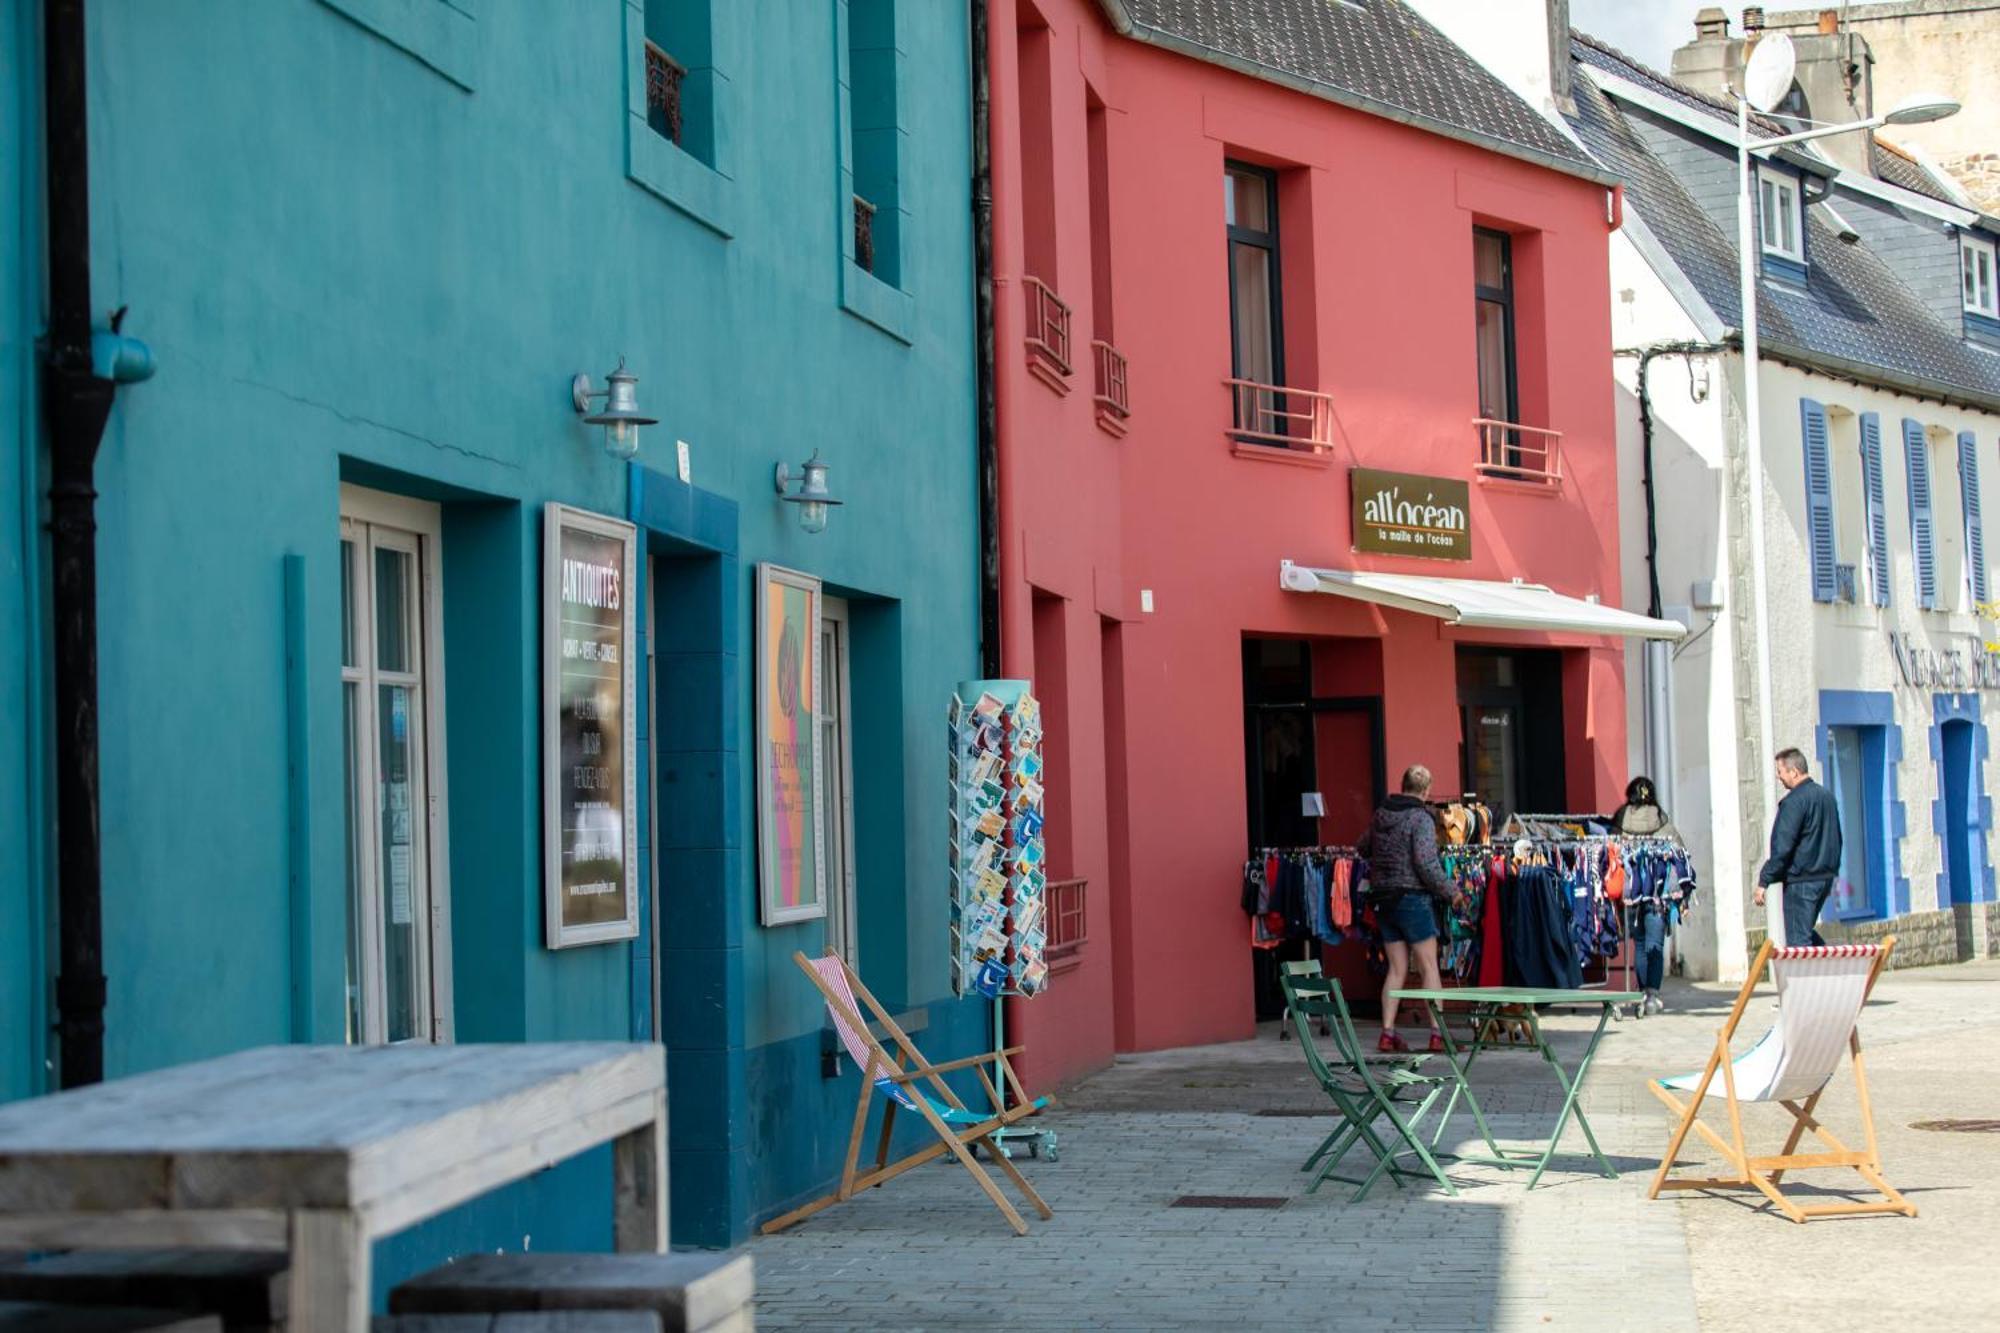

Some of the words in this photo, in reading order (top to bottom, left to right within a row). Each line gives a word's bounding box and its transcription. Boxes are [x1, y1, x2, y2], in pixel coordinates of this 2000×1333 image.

[1364, 486, 1465, 530] all'océan
[1378, 528, 1387, 541] la
[1415, 531, 1424, 544] de
[562, 559, 620, 610] ANTIQUITÉS
